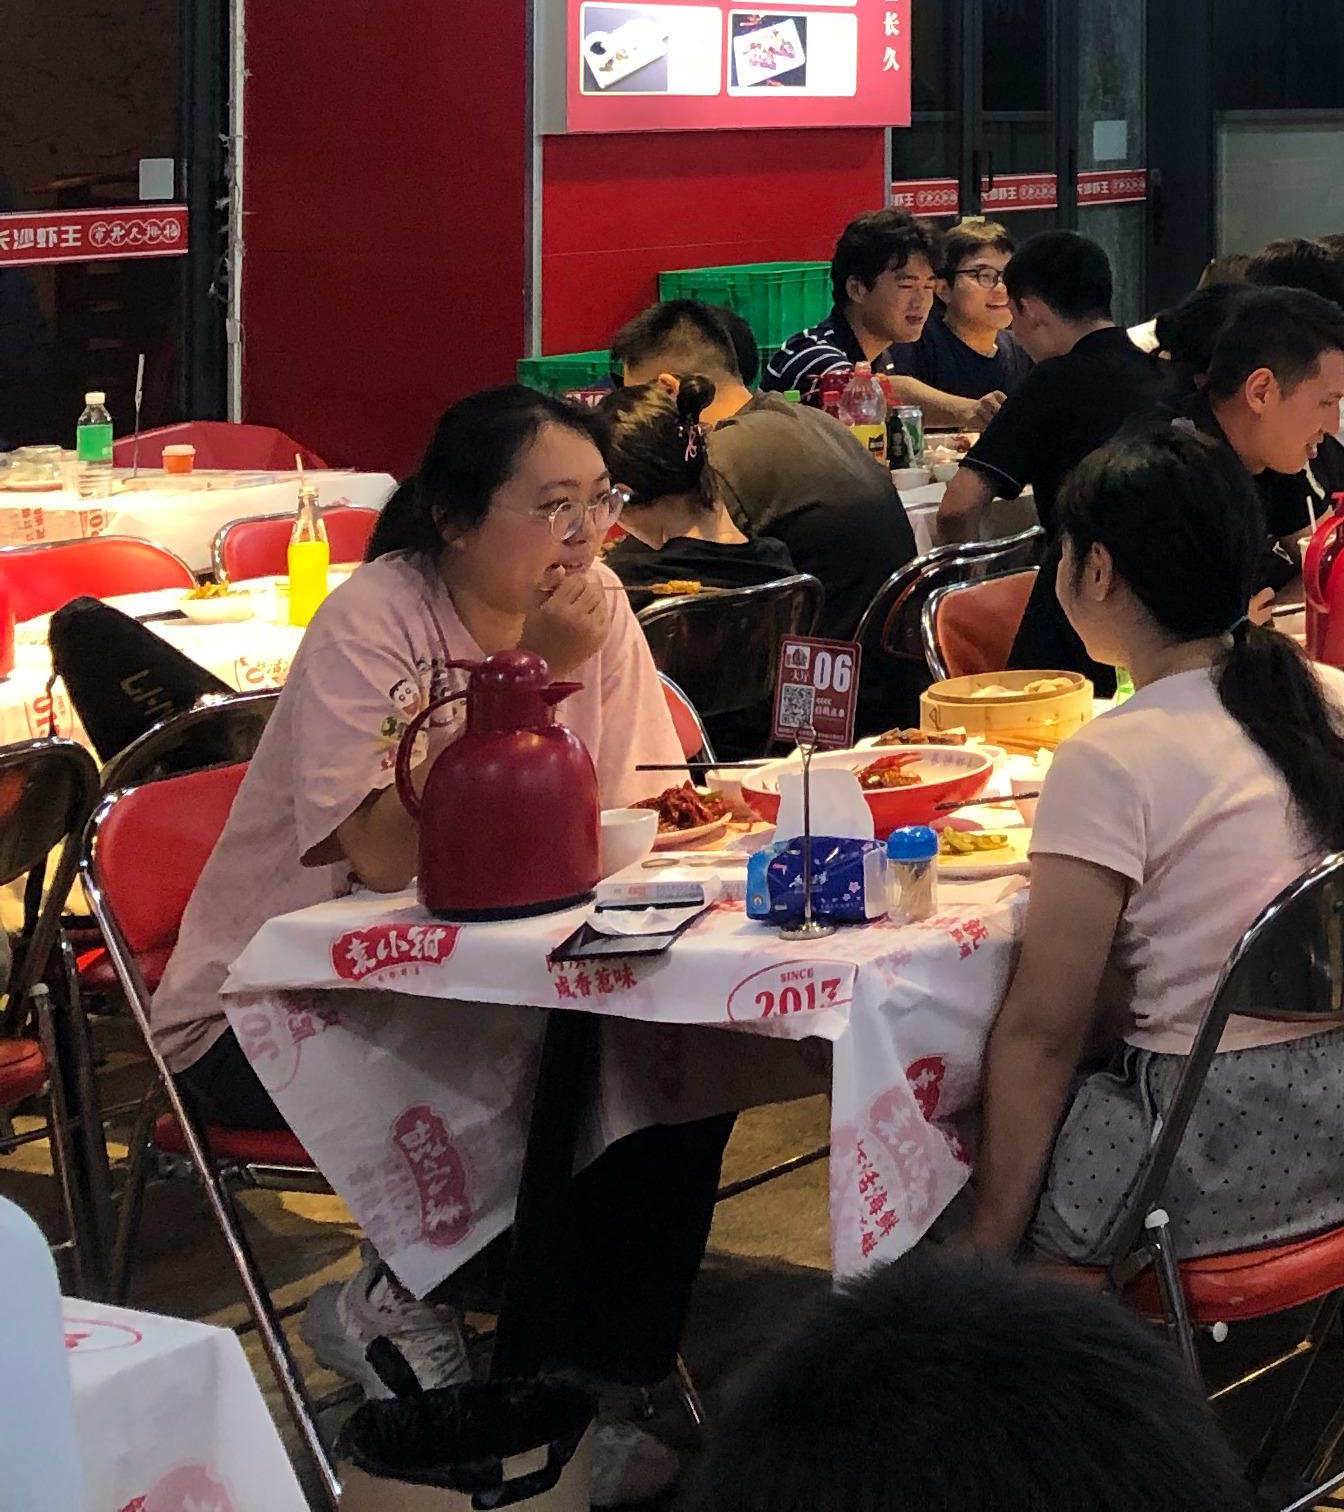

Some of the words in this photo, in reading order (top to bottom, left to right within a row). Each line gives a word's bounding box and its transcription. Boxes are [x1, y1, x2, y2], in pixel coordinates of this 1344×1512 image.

[0, 225, 82, 250] 长沙虾王
[813, 651, 852, 693] 06
[780, 967, 814, 983] SINCE
